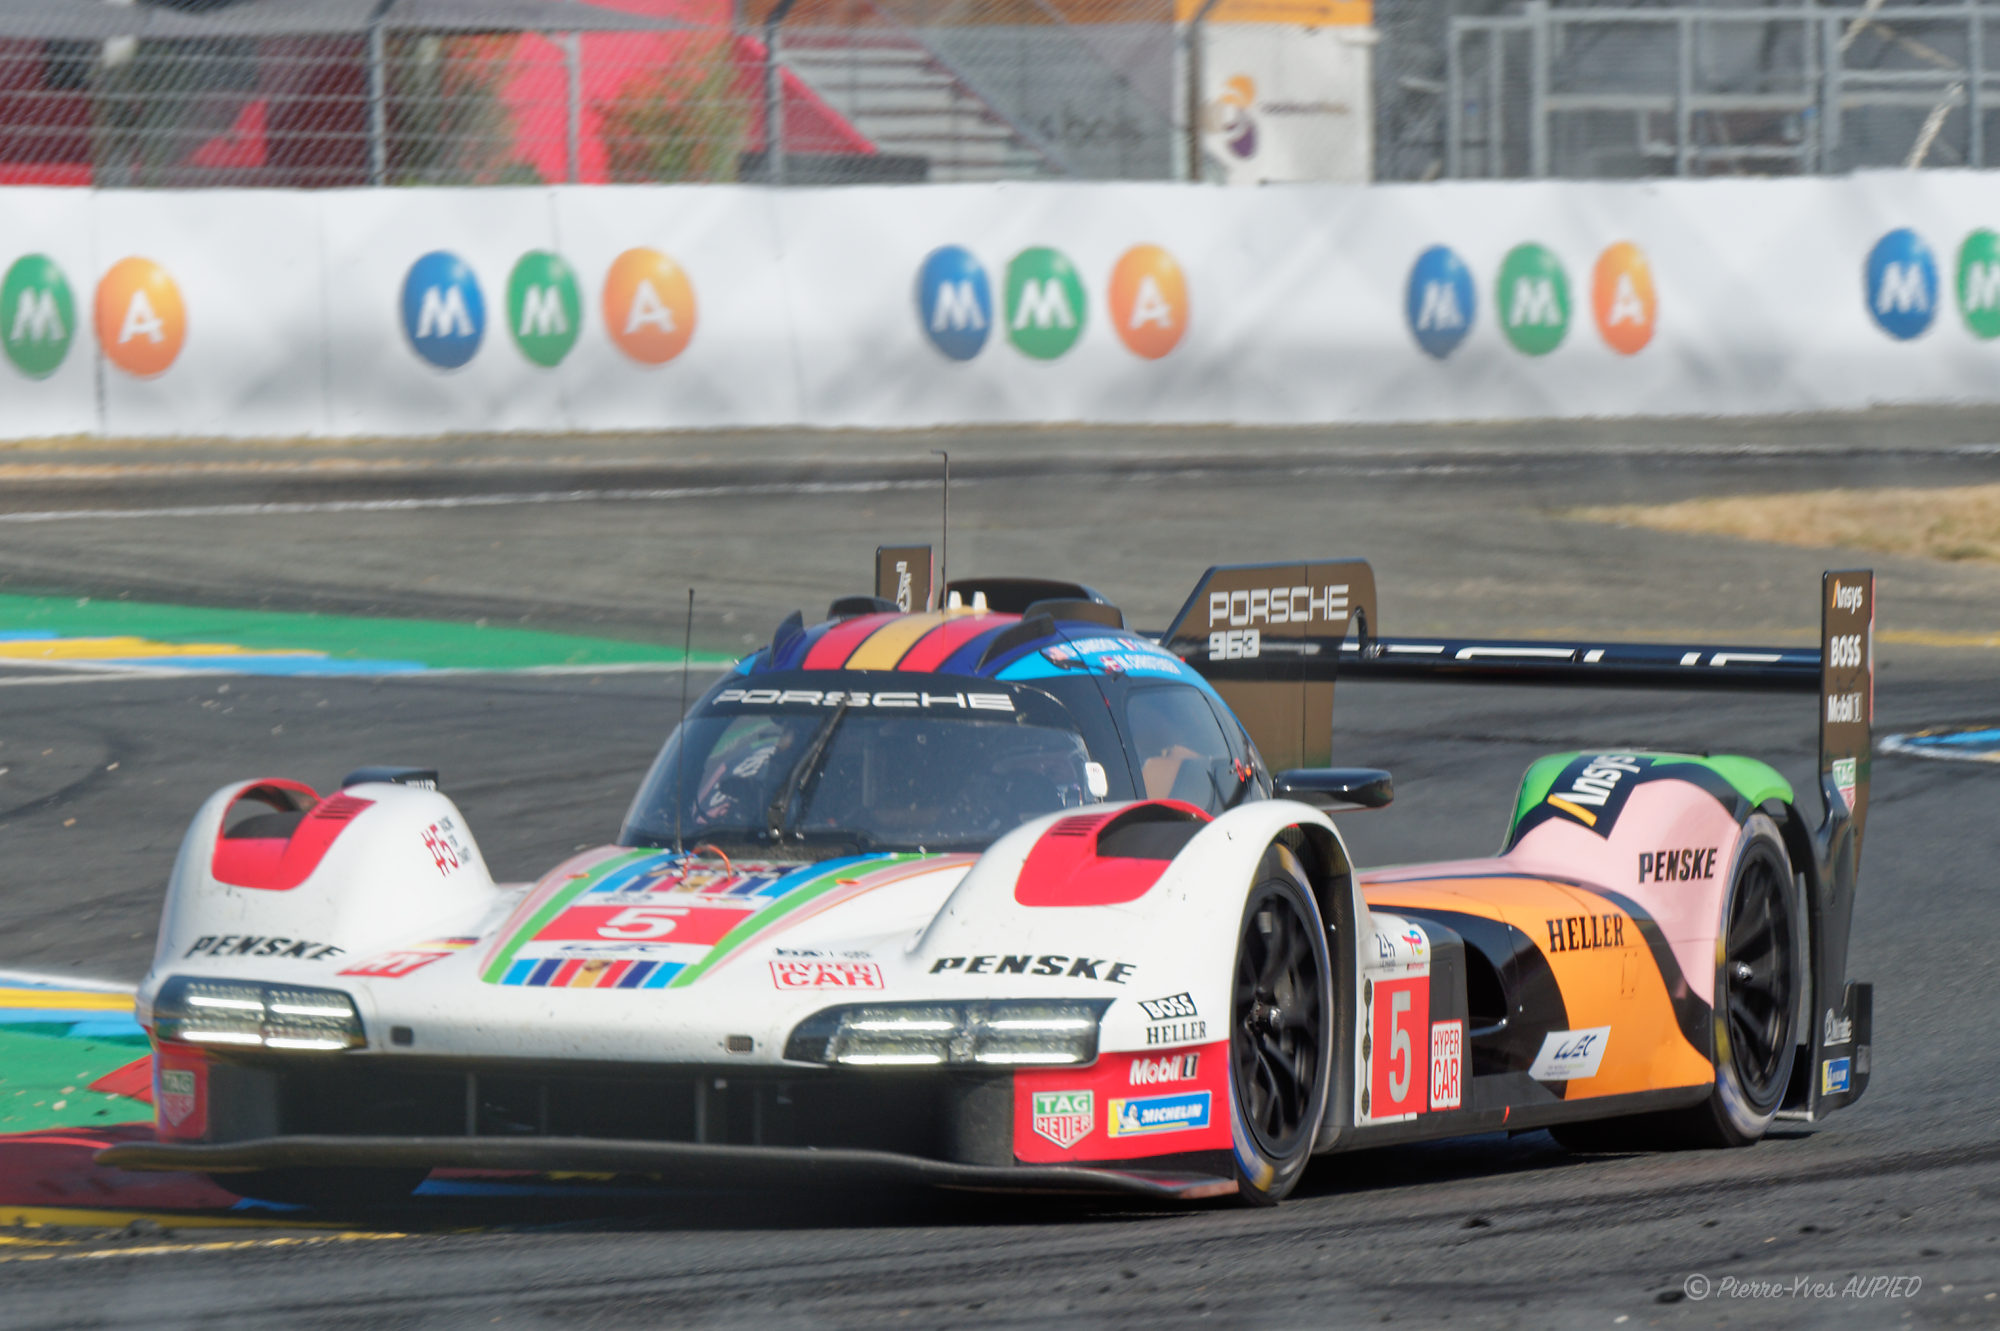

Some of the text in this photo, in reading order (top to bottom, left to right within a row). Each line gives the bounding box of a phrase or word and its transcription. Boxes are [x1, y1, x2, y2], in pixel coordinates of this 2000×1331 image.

[1209, 584, 1349, 628] PORSCHE
[1832, 578, 1863, 614] Ansys
[1209, 628, 1260, 661] 963
[1830, 635, 1862, 667] BOSS
[712, 689, 1016, 712] PORSCHE
[1639, 847, 1718, 884] PENSKE
[597, 907, 690, 939] 5
[1547, 914, 1625, 953] HELLER
[184, 935, 346, 960] PENSKE
[781, 971, 874, 986] CAR
[928, 955, 1137, 985] PENSKE
[1141, 994, 1196, 1019] BOSS
[1146, 1021, 1207, 1045] HELLER
[1389, 989, 1412, 1104] 5
[1433, 1029, 1460, 1057] HYPER
[1129, 1056, 1182, 1086] Mobil
[1432, 1058, 1459, 1101] CAR
[1038, 1095, 1089, 1114] TAG
[1141, 1104, 1203, 1124] MICHELIN
[1037, 1115, 1093, 1143] HEUER
